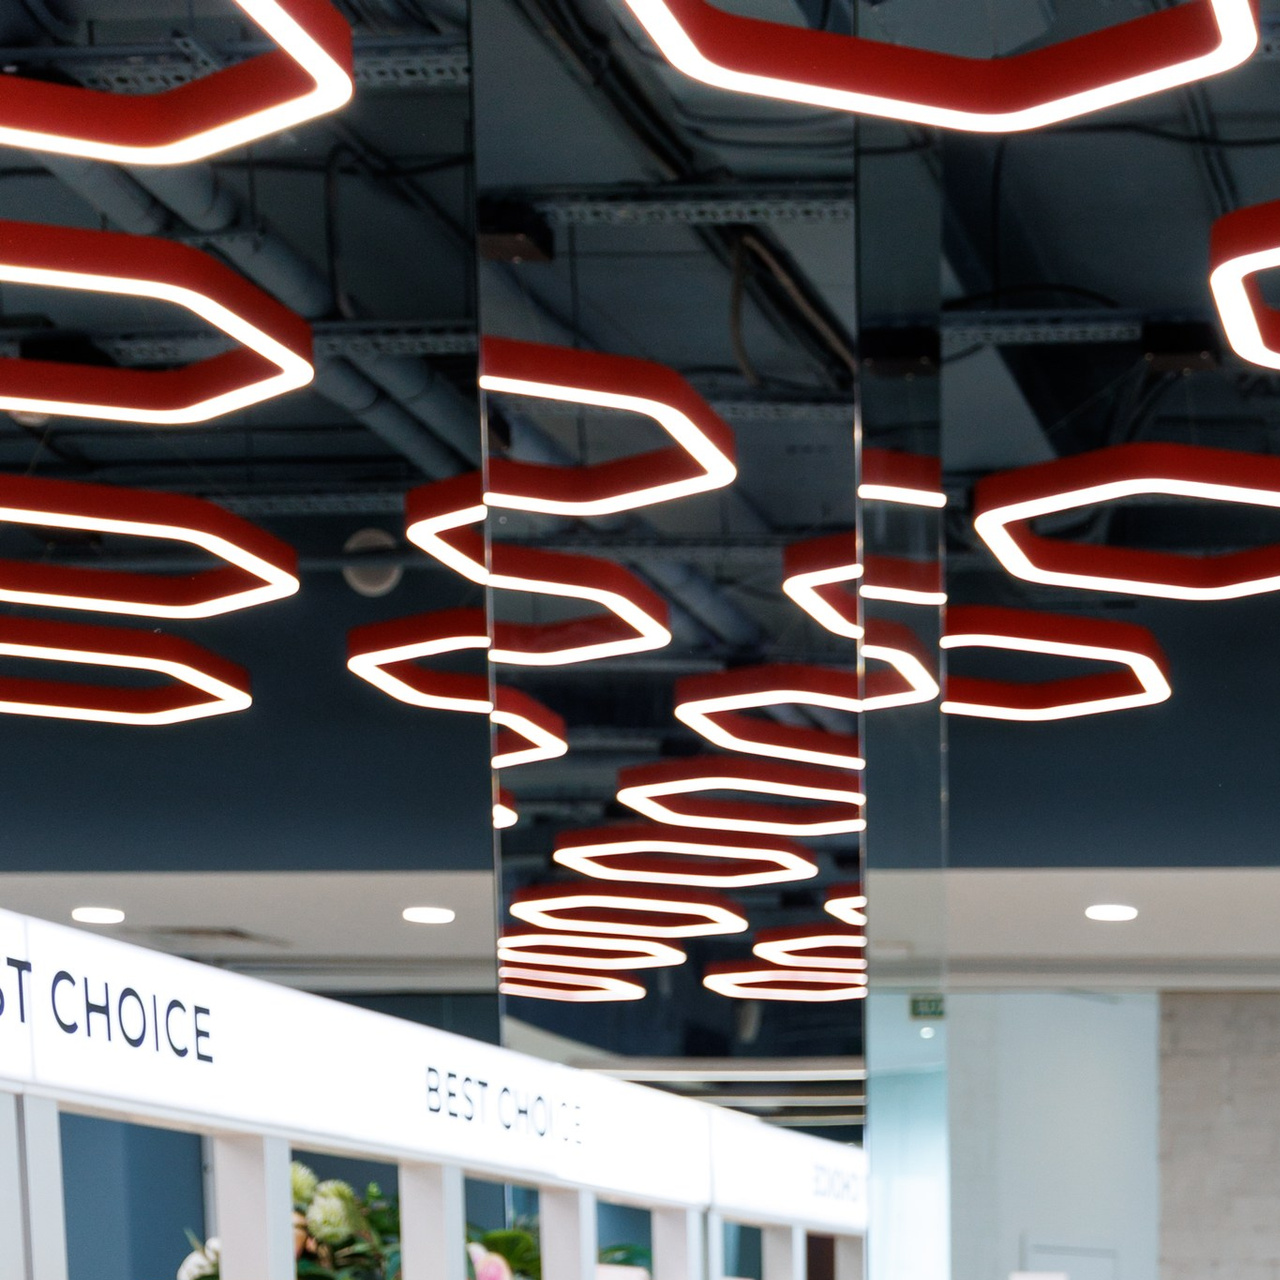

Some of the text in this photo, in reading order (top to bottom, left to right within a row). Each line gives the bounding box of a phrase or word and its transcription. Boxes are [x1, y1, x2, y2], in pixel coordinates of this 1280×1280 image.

[0, 956, 213, 1063] T CHOICE
[427, 1067, 488, 1123] BEST
